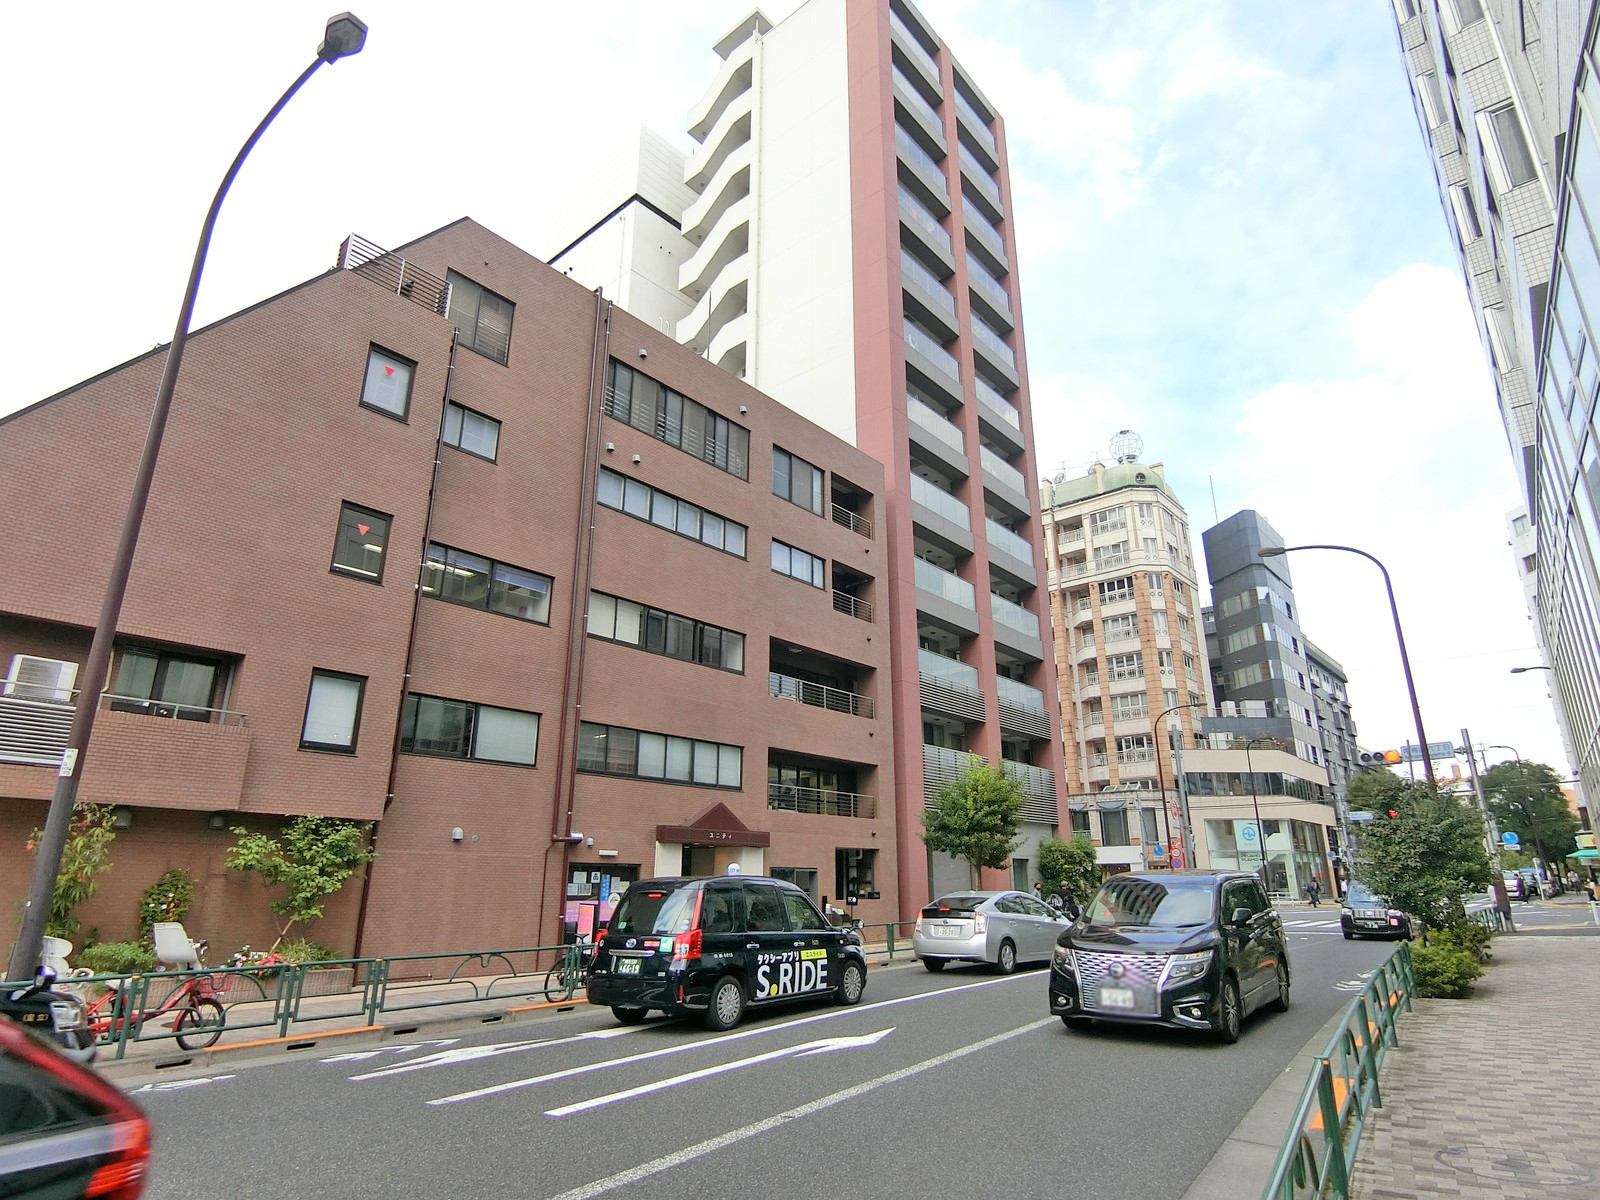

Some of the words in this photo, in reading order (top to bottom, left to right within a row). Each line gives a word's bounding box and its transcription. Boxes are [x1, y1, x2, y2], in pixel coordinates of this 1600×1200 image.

[757, 951, 800, 965] タクシーアプリ
[756, 959, 828, 998] S.RIDE
